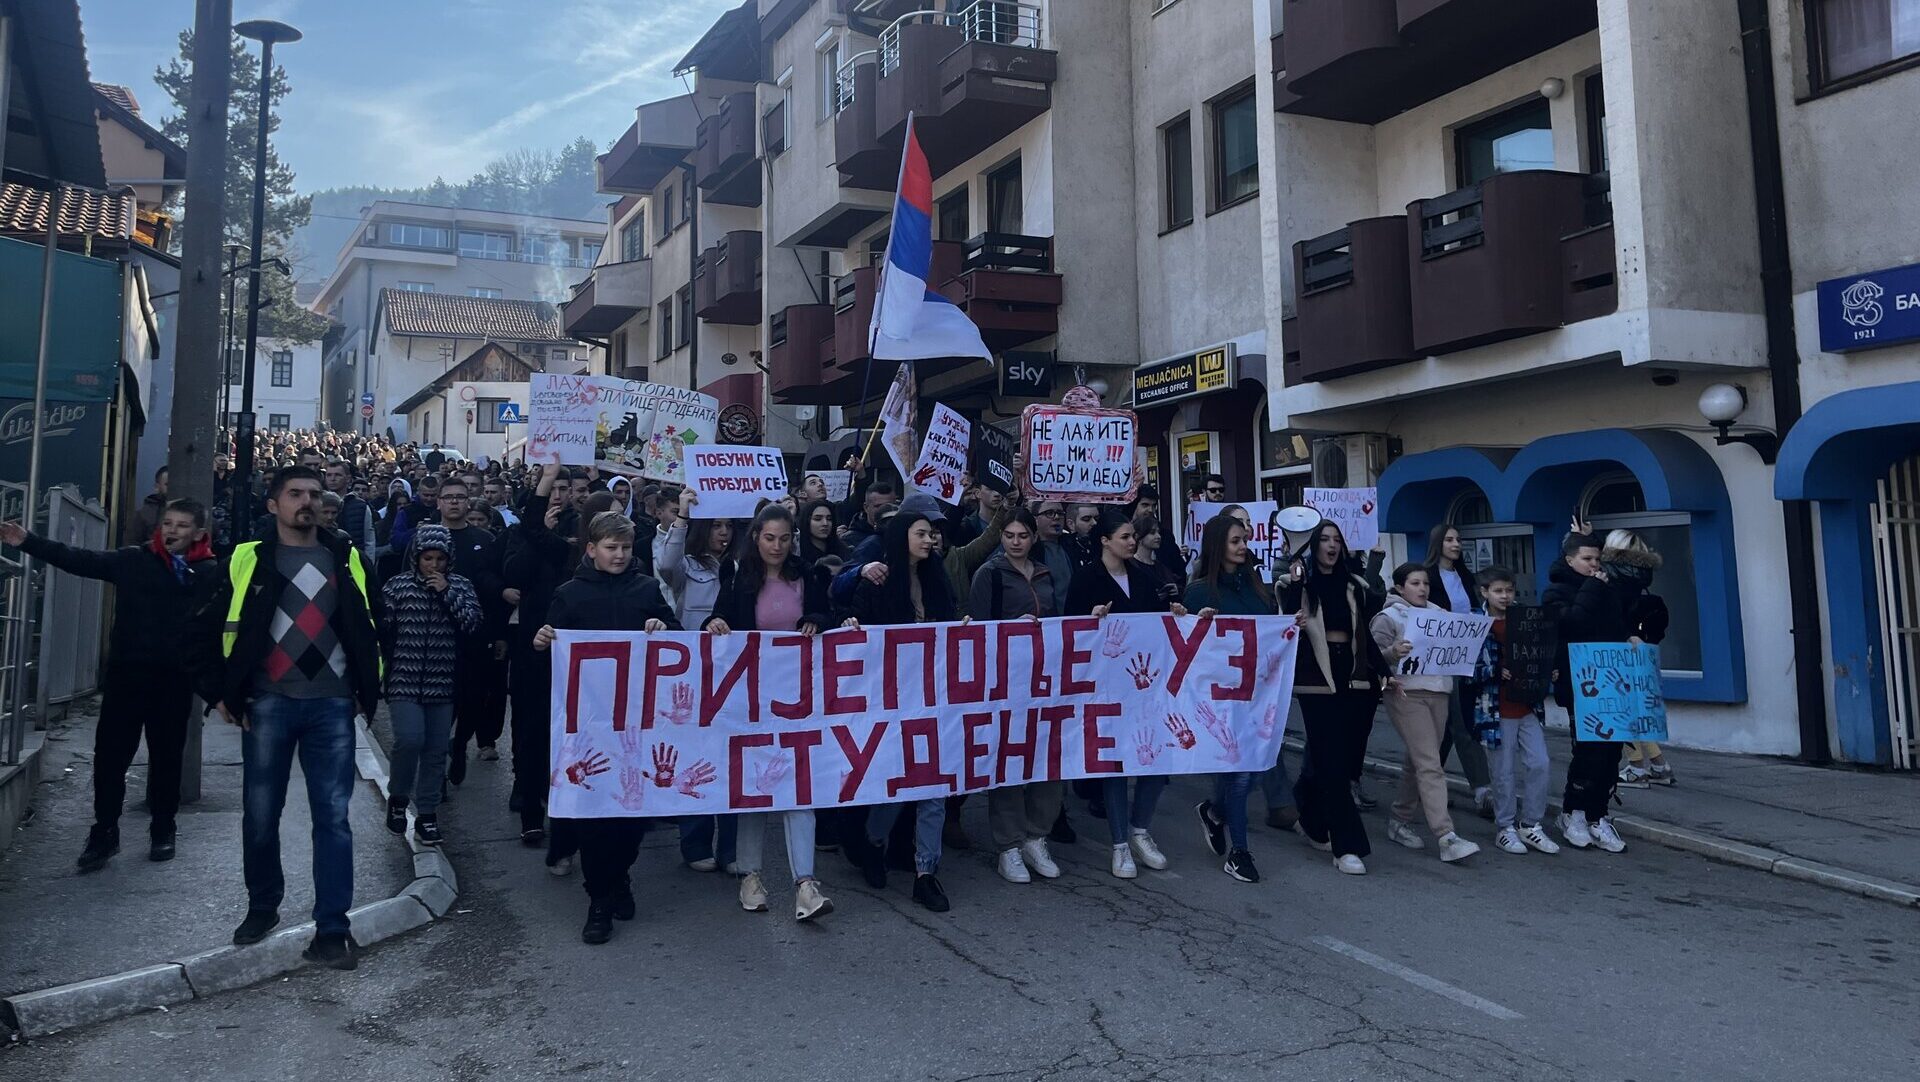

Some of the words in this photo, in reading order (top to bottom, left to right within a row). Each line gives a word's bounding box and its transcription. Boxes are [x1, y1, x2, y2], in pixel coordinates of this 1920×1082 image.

[1854, 328, 1875, 340] 1921
[546, 375, 588, 393] ЛАЖ
[1009, 361, 1044, 386] sky
[1136, 364, 1193, 389] MENJAČNICA
[624, 380, 702, 404] СТОПАМА
[1140, 386, 1169, 400] EXCHANGE
[1169, 381, 1189, 393] OFFICE
[658, 399, 716, 424] СТУДЕНАТА
[928, 431, 946, 445] КАКО
[1033, 420, 1053, 441] НЕ
[1061, 420, 1130, 441] ЛАЖИТЕ
[695, 453, 755, 467] ПОБУНИ
[757, 453, 775, 467] СЕ
[699, 477, 762, 494] ПРОБУДИ
[765, 477, 782, 491] СЕ
[1033, 462, 1075, 485] БАБУ
[1080, 467, 1089, 482] И
[1092, 467, 1132, 489] ДЕДУ
[1416, 616, 1489, 639] ЧЕКАЈУЋИ
[565, 618, 1100, 734] ПРИЈЕПОЉЕ
[729, 702, 1124, 809] СТУДЕНТЕ
